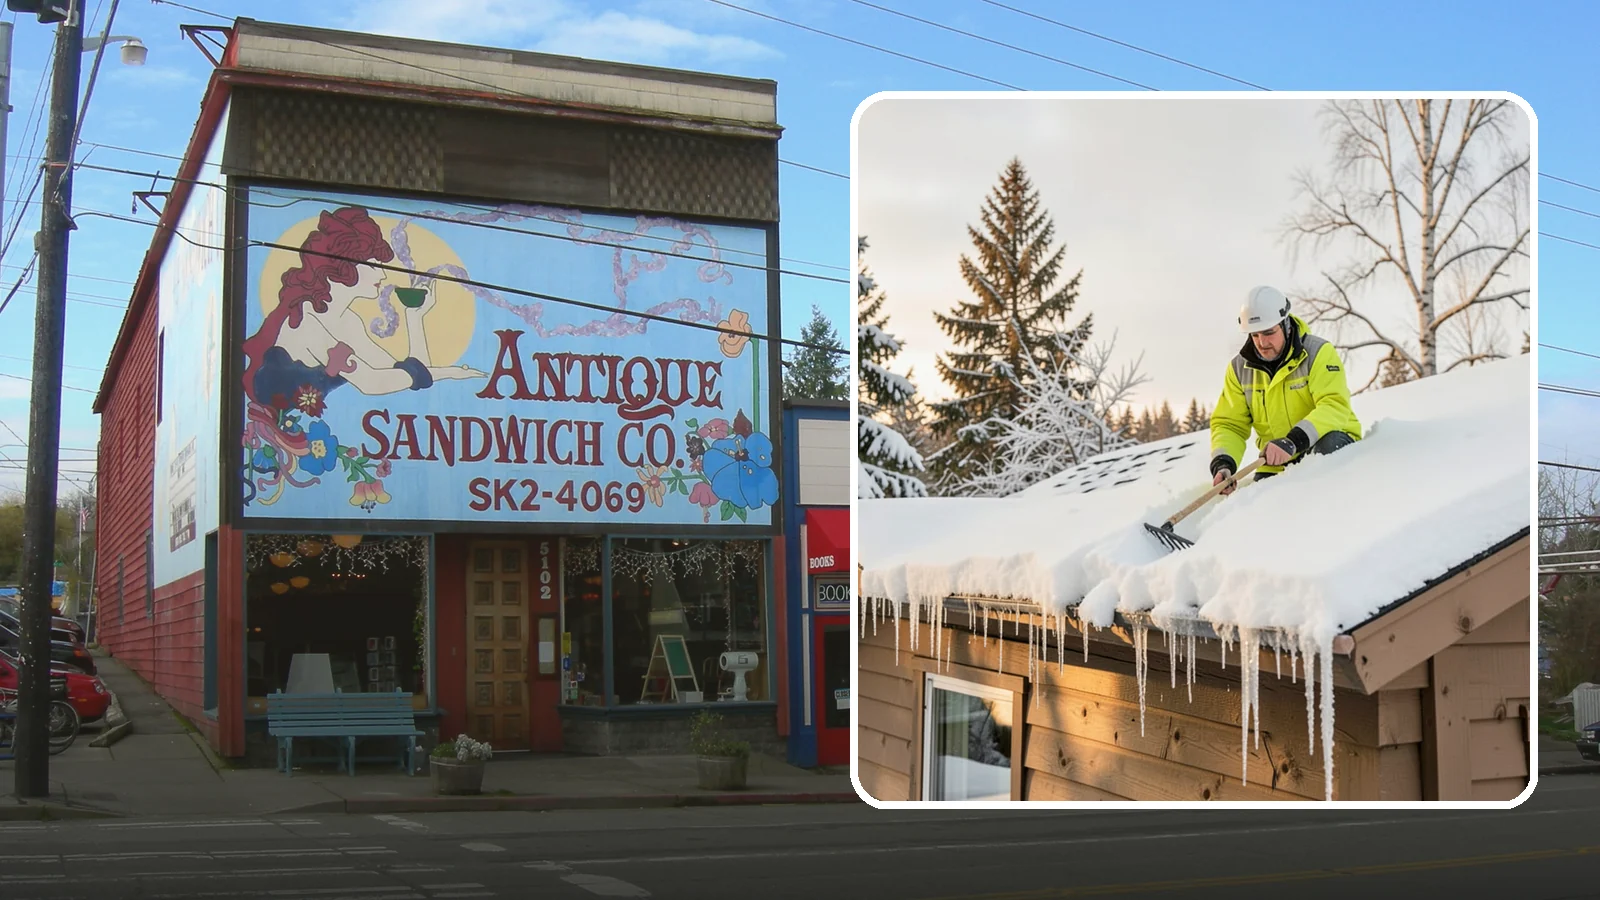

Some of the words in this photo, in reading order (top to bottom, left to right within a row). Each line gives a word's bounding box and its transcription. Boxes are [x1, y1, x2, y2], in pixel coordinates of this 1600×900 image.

[476, 329, 723, 420] ANTIQUE
[361, 409, 604, 467] SANDWICH
[616, 421, 685, 468] CO.
[468, 476, 645, 512] SK2-4069
[540, 541, 551, 600] 5102
[809, 555, 835, 569] BOOKS
